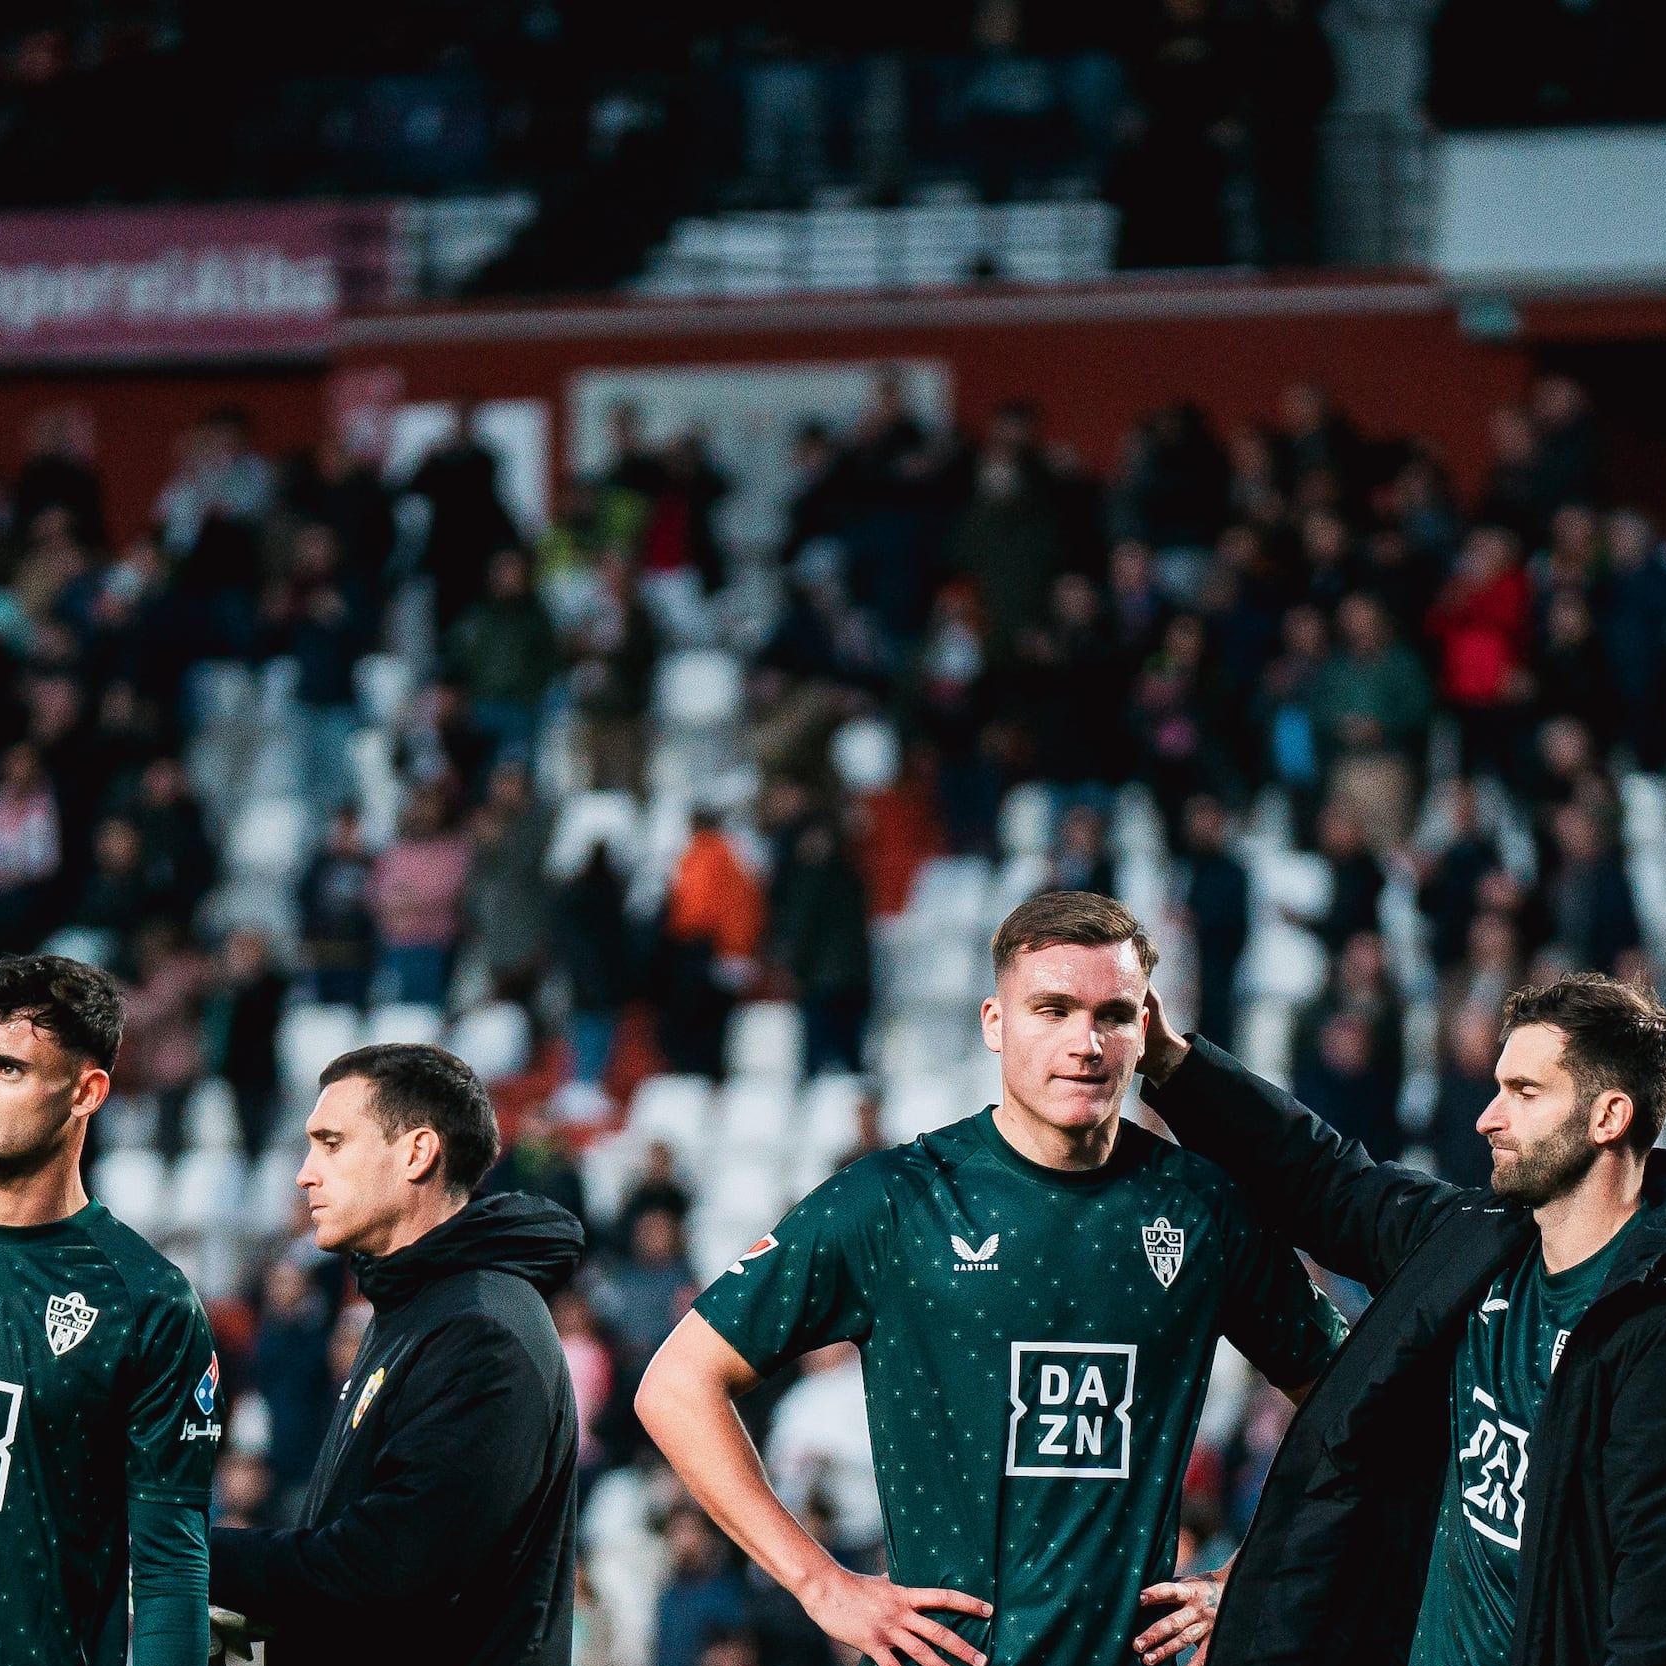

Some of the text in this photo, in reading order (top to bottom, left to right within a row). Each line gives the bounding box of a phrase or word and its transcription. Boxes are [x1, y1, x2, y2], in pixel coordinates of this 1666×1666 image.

[953, 1263, 999, 1272] CASTORE
[1039, 1364, 1109, 1407] DA
[1038, 1414, 1103, 1456] ZN
